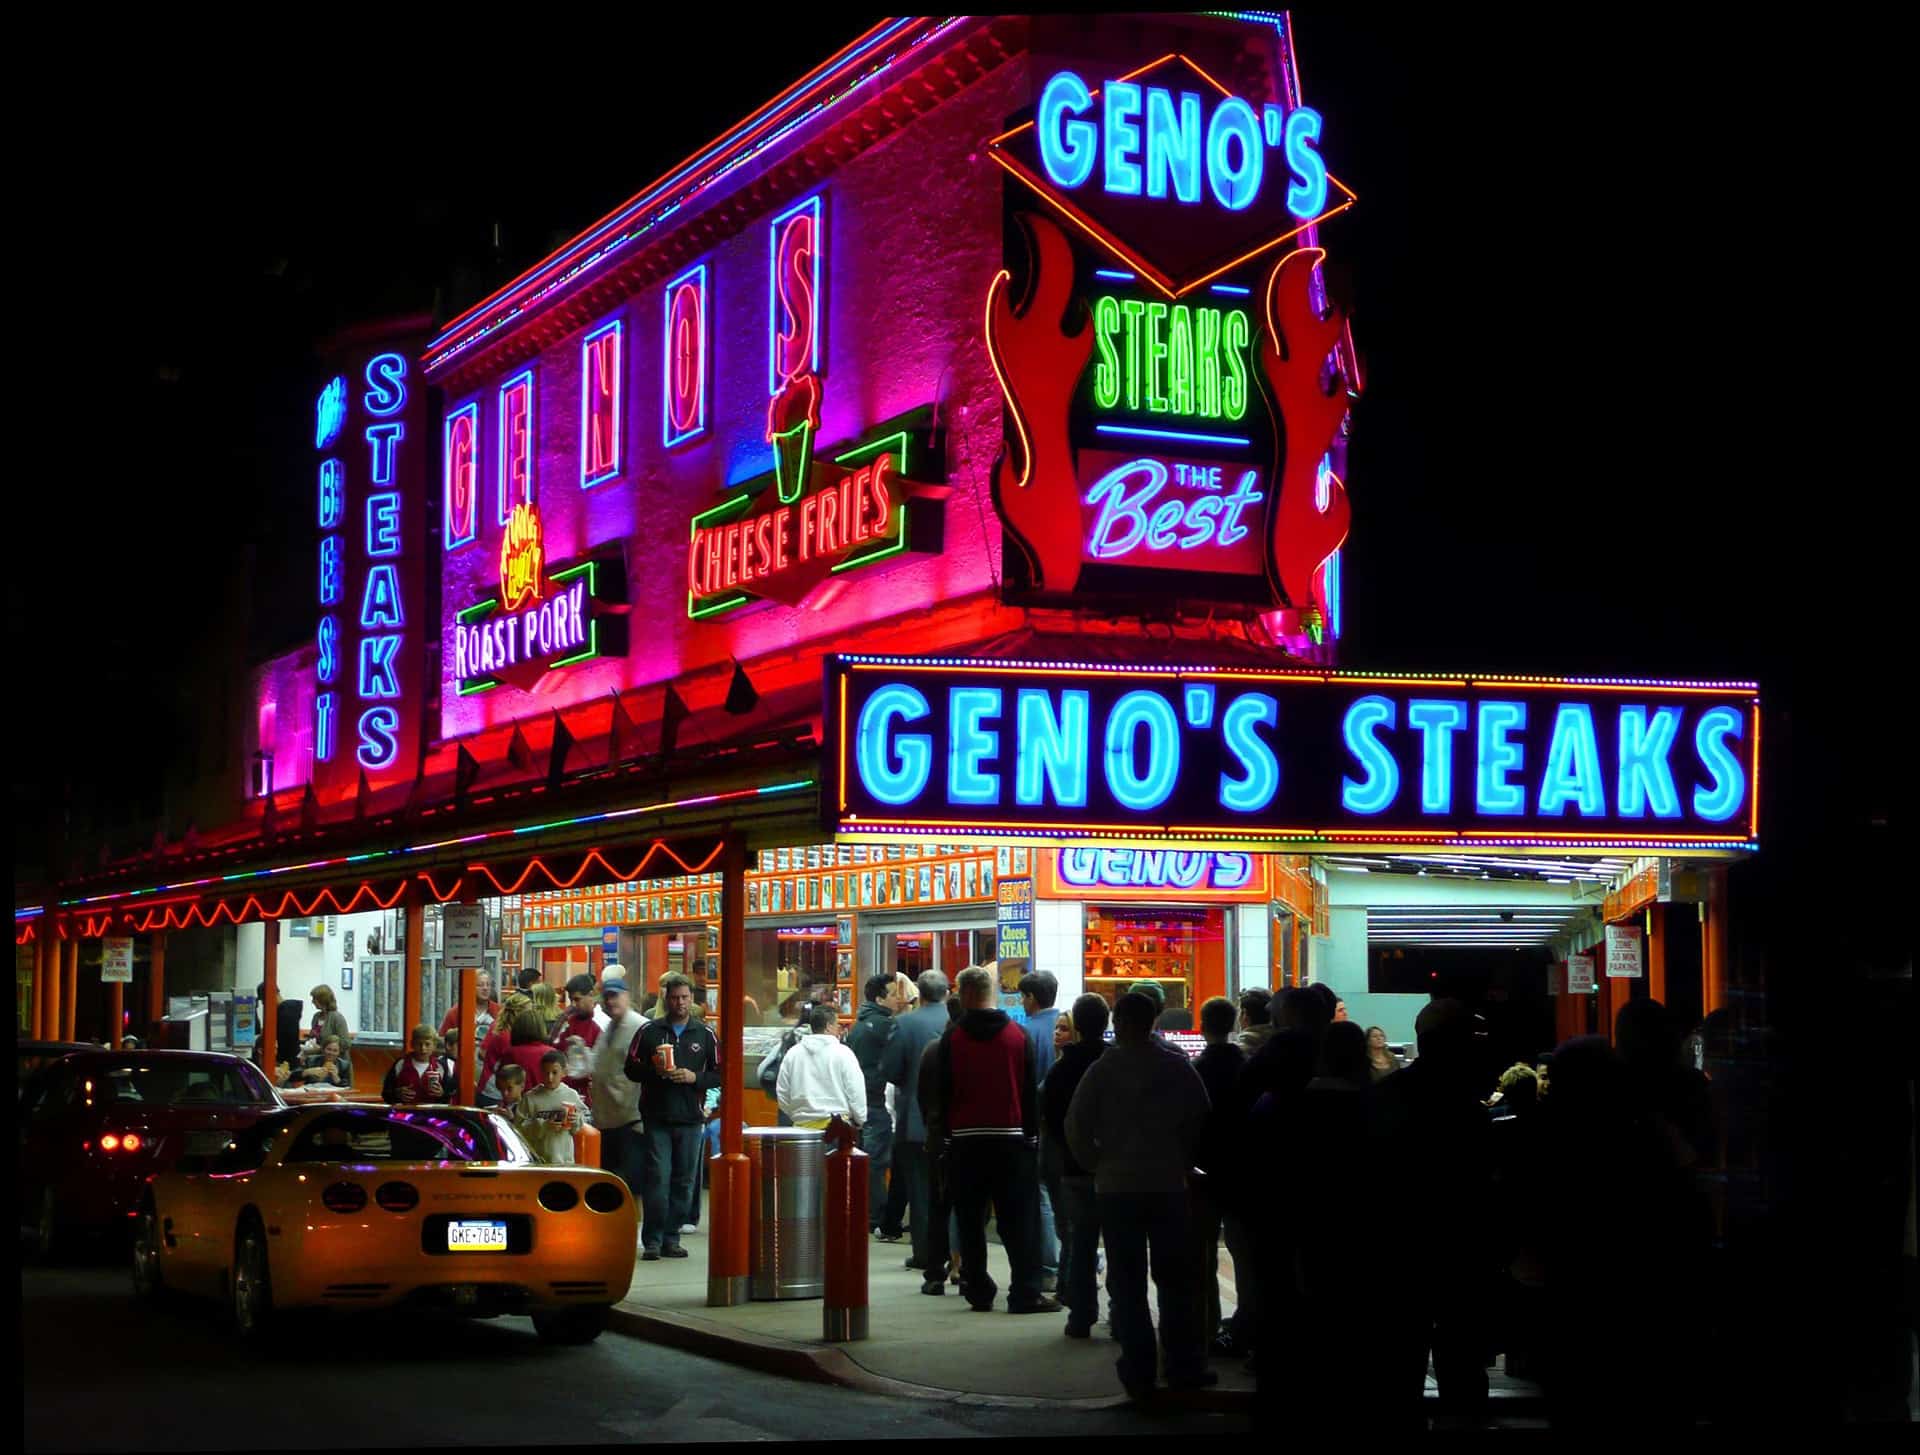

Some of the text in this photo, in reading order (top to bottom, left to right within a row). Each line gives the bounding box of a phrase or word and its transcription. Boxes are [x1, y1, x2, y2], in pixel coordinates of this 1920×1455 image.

[1038, 70, 1330, 219] GENO'S
[1094, 295, 1249, 421] STEAKS
[688, 452, 890, 599] CHEESE FRIES
[1085, 458, 1264, 558] Best
[1174, 463, 1222, 490] THE
[316, 458, 344, 761] BEST
[355, 353, 408, 770] STEAKS
[455, 577, 585, 679] ROAST PORK
[856, 683, 1745, 821] GENO'S STEAKS
[1059, 848, 1253, 889] GENOS
[999, 940, 1030, 958] STEAK
[1002, 925, 1028, 940] Cheese
